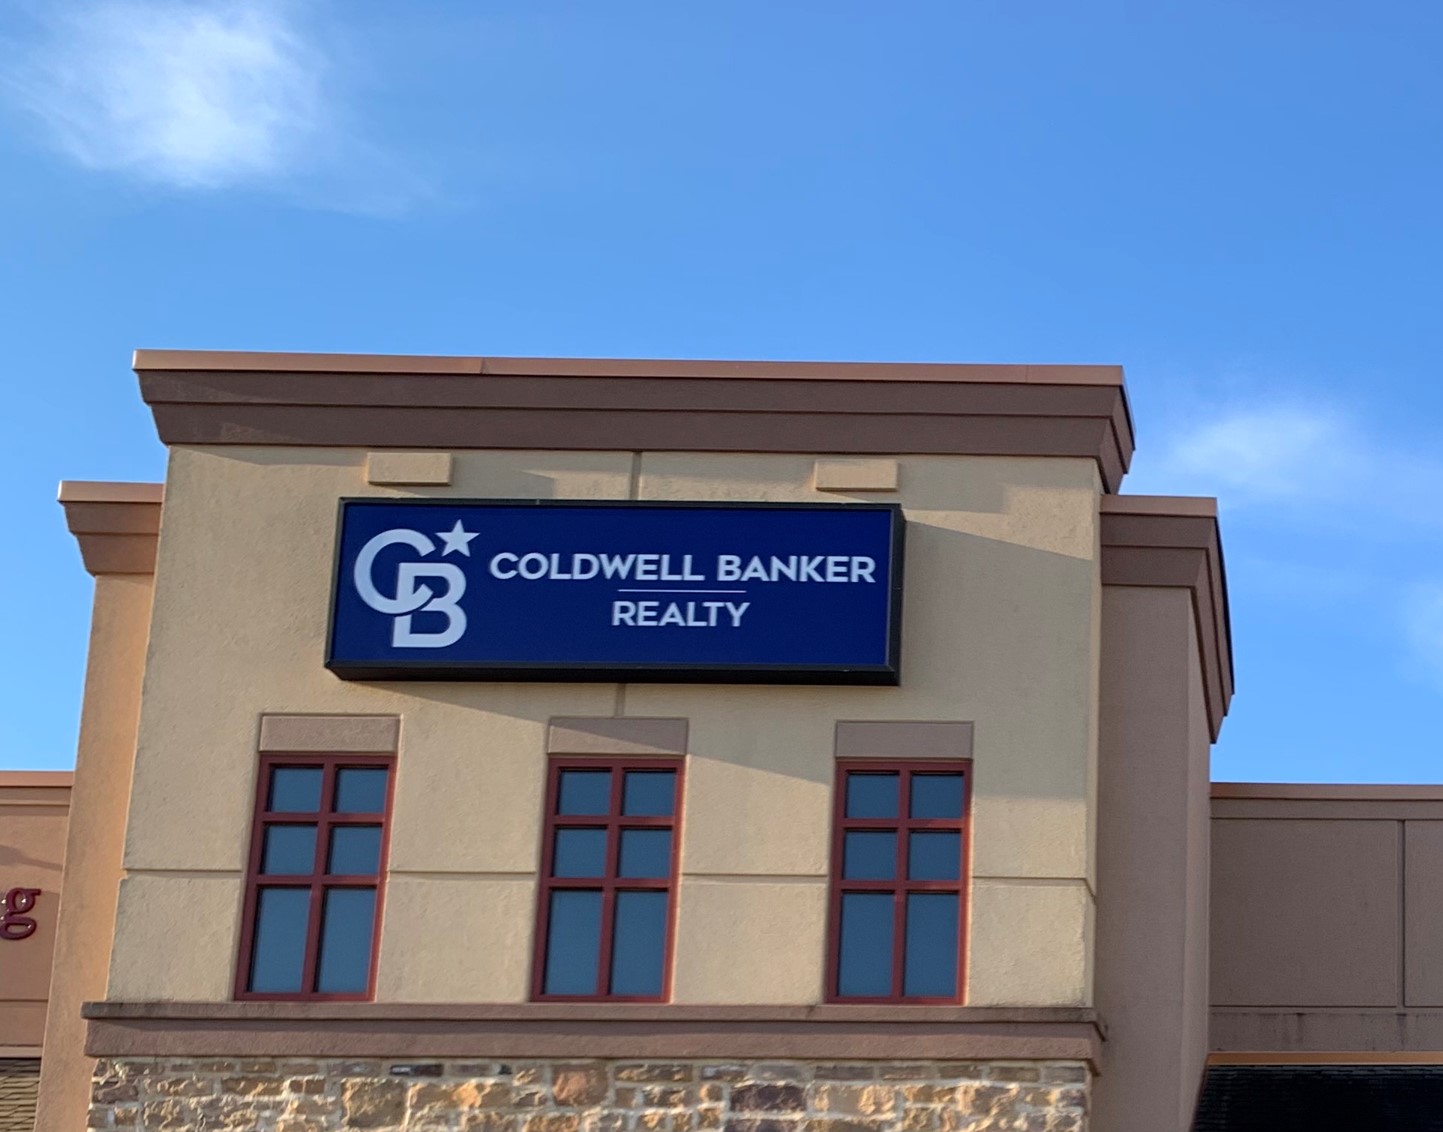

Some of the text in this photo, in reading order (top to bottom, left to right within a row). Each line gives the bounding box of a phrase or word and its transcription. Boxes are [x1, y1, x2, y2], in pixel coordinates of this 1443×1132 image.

[489, 552, 876, 583] COLDWELL BANKER
[354, 528, 467, 648] CB
[611, 600, 750, 627] REALTY
